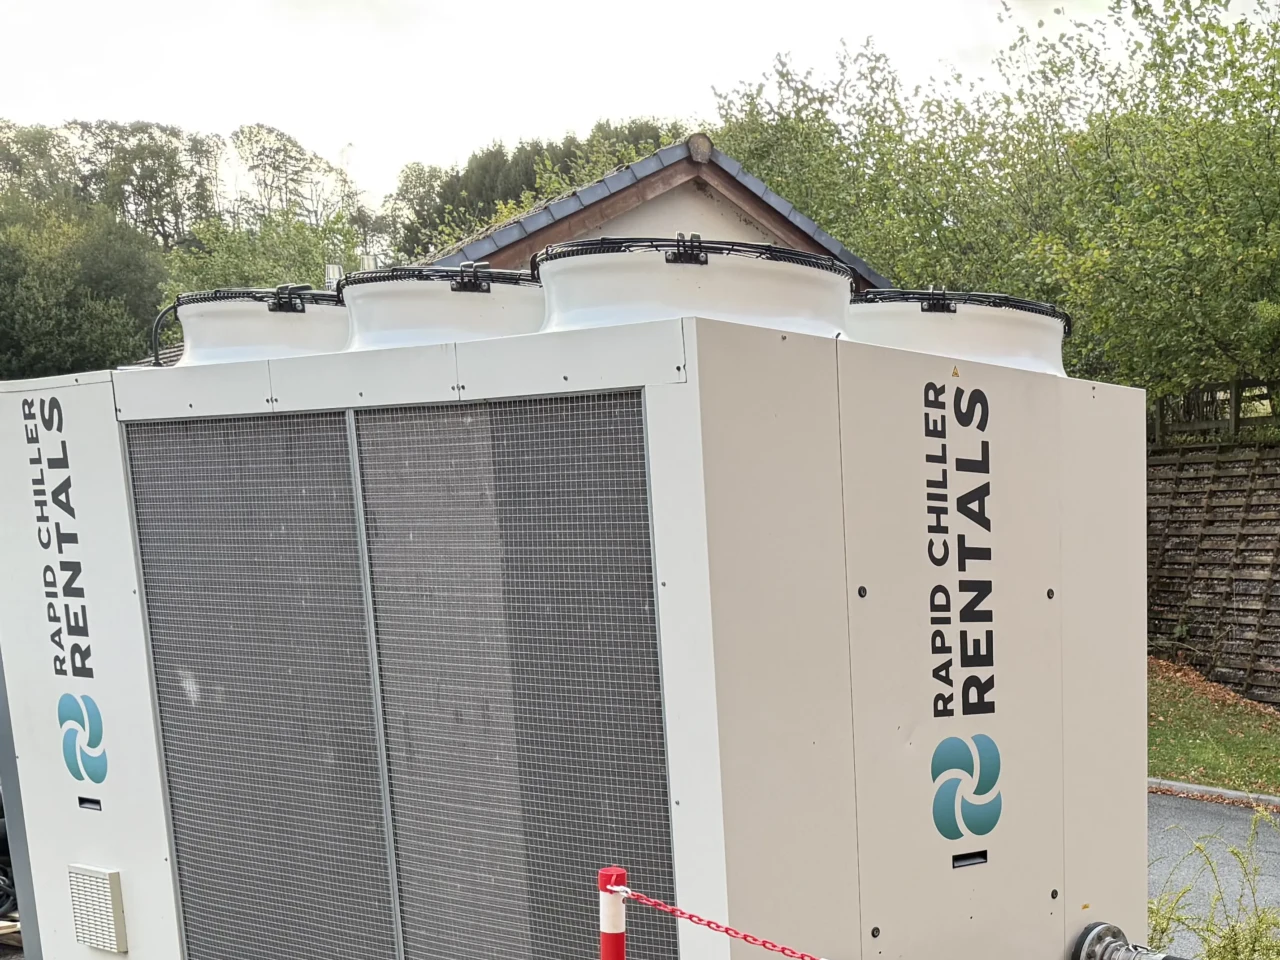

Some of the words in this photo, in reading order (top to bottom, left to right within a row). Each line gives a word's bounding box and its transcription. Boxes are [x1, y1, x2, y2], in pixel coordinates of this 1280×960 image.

[22, 398, 52, 550] CHILLER
[40, 396, 94, 679] RENTALS
[924, 381, 950, 566] CHILLER
[954, 386, 996, 716] RENTALS
[43, 564, 68, 676] RAPID
[930, 584, 954, 718] RAPID
